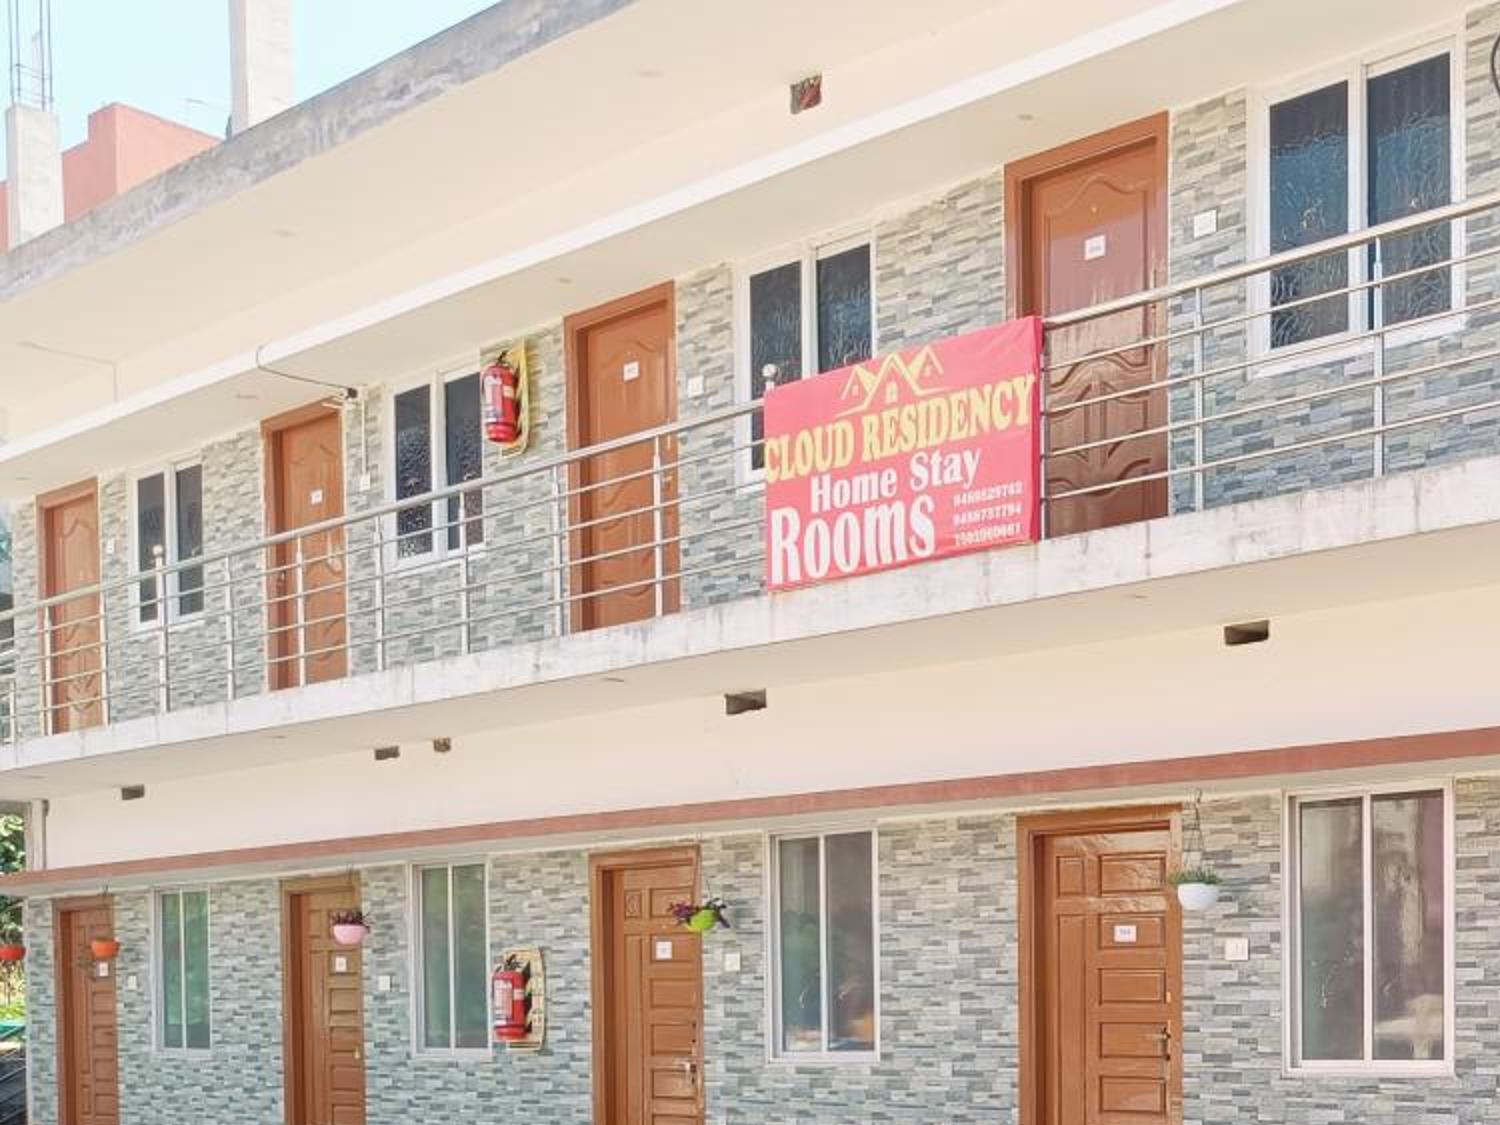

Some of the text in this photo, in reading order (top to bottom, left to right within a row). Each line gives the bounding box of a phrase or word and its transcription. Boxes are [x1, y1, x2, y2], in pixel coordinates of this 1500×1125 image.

[764, 373, 1036, 484] CLOUD RESIDENCY
[811, 448, 981, 513] Home Stay
